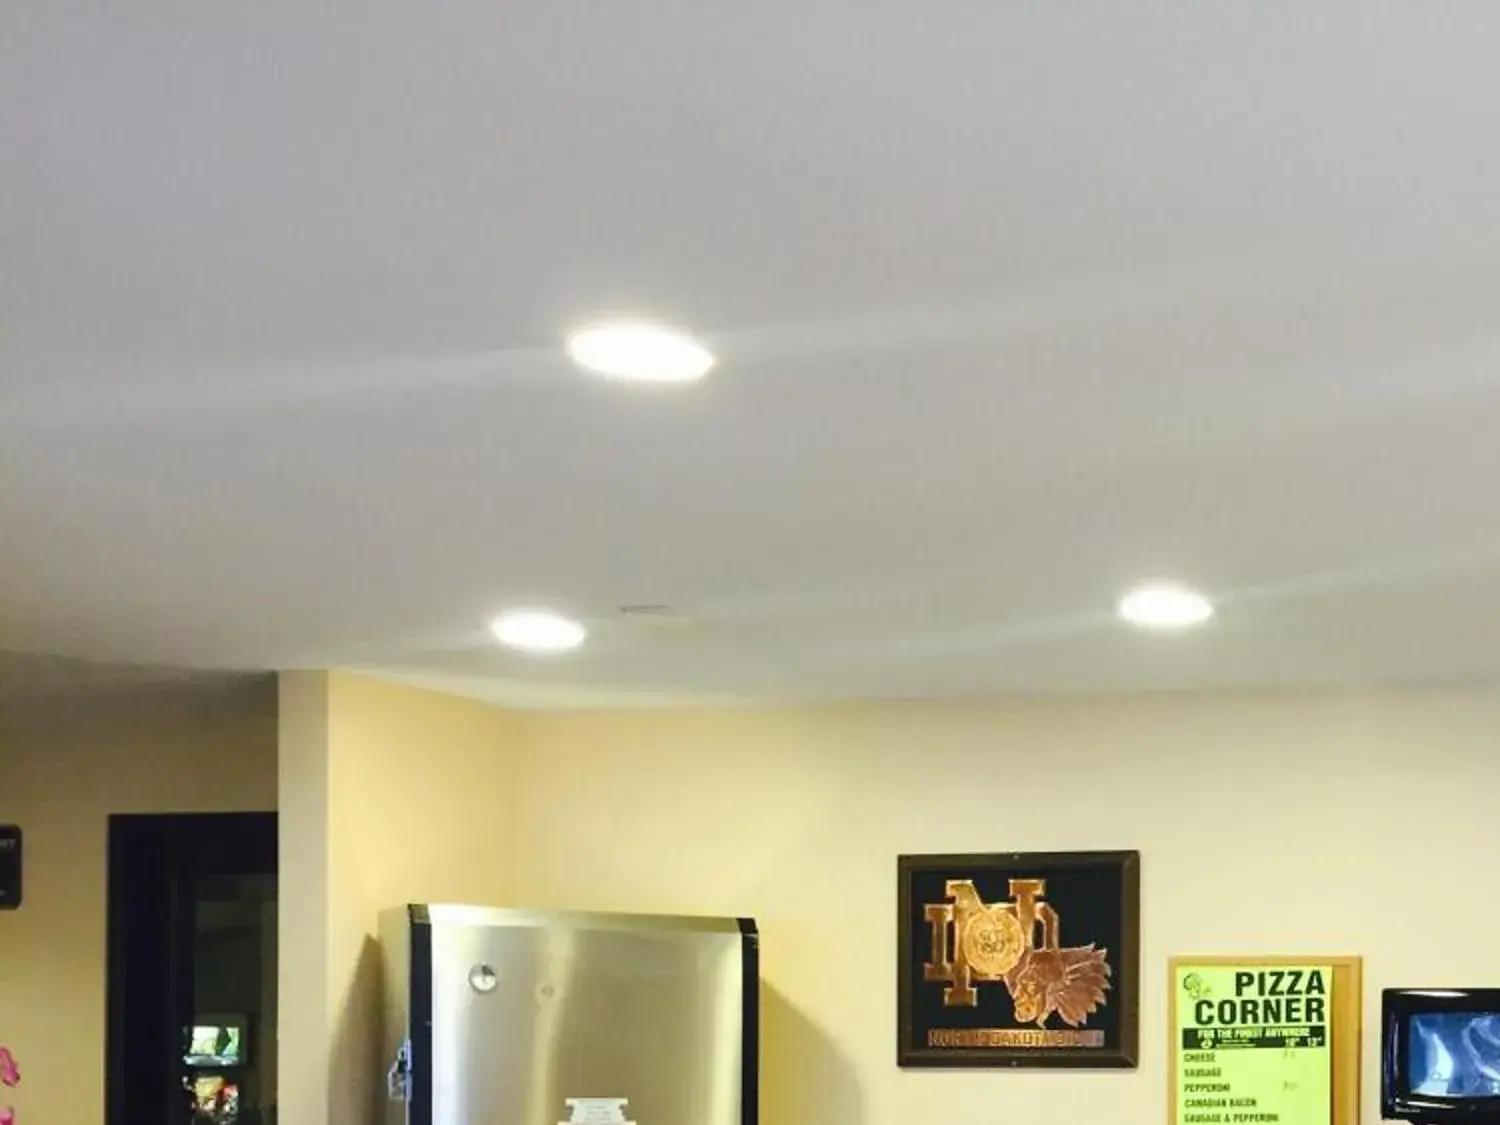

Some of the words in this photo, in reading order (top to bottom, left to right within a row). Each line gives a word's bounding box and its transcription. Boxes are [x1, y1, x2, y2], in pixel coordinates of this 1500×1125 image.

[1235, 970, 1325, 997] PIZZA
[1194, 999, 1325, 1026] CORNER
[1184, 1053, 1216, 1062] CHEESE
[1184, 1067, 1221, 1077] SAUSAGE
[1184, 1082, 1230, 1092] PEPPERONI
[1184, 1098, 1226, 1108] CANADIAN
[1229, 1098, 1257, 1107] BACON
[1184, 1114, 1221, 1123] SAUSAGE
[1233, 1113, 1279, 1123] PEPPERONI
